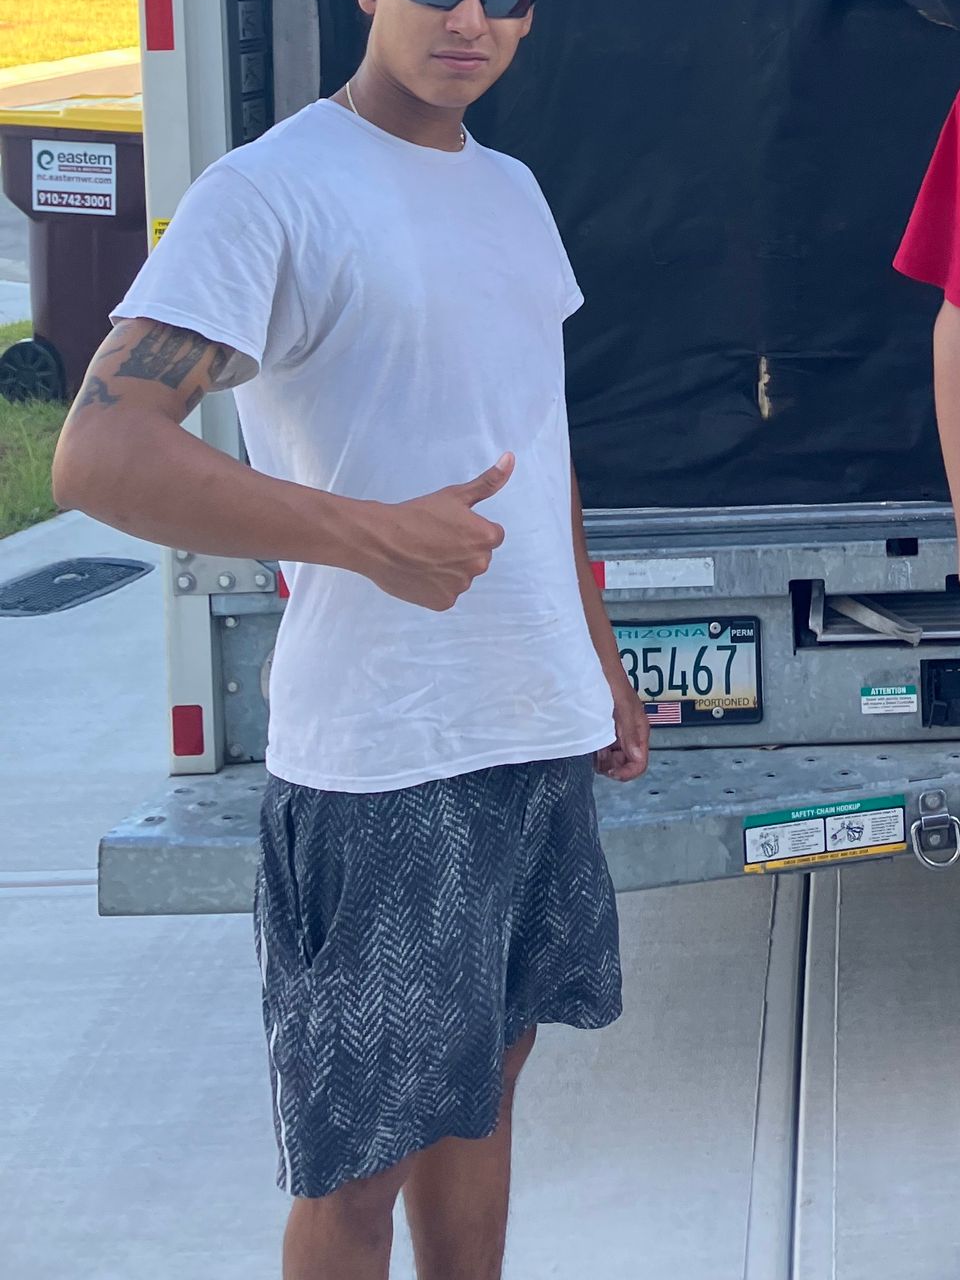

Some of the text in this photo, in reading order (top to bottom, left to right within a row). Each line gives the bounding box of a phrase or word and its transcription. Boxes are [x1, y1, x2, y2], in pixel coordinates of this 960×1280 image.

[57, 151, 113, 165] eastern
[38, 192, 111, 208] 910-742-3001
[617, 628, 754, 639] RIZONA PERM
[871, 686, 906, 695] ATTENTION
[836, 803, 861, 812] HOOKUP
